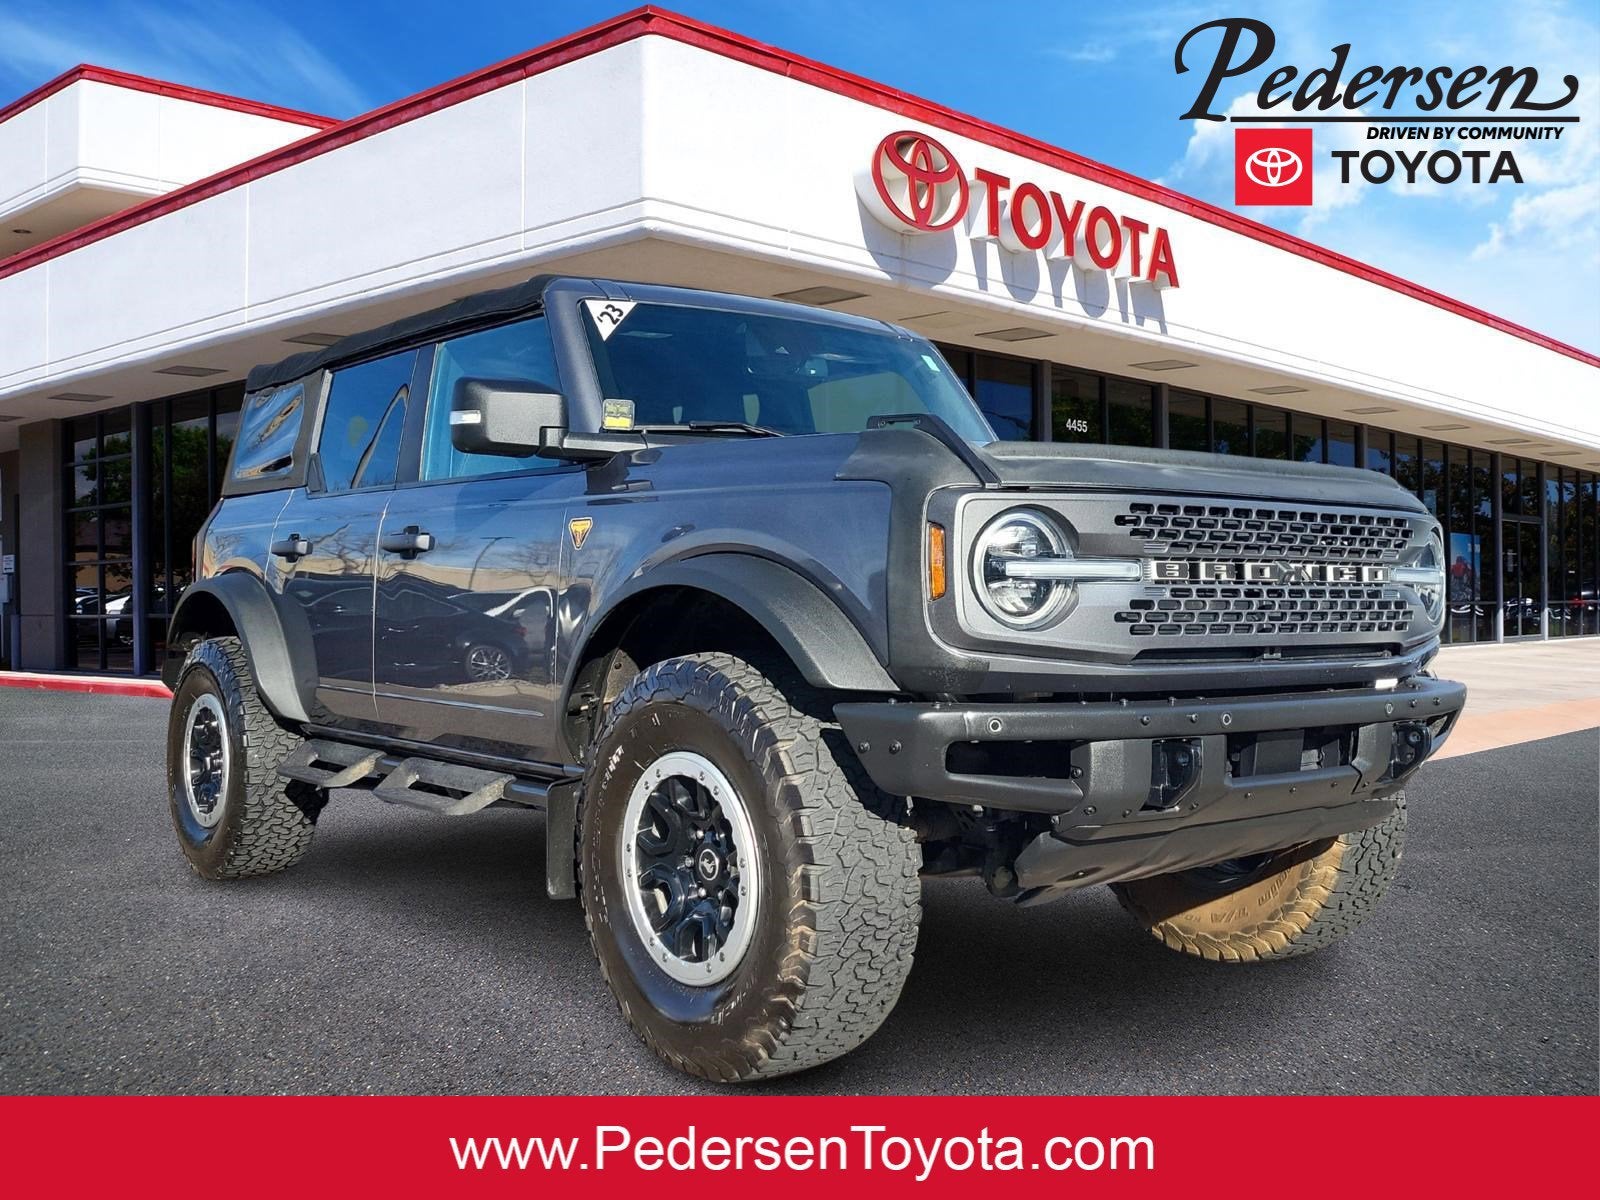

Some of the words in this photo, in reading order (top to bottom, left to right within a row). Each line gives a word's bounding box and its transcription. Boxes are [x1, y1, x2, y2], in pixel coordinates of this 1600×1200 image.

[975, 167, 1180, 288] TOYOTA
[1065, 418, 1089, 433] 4455
[1150, 560, 1390, 584] BRONCO
